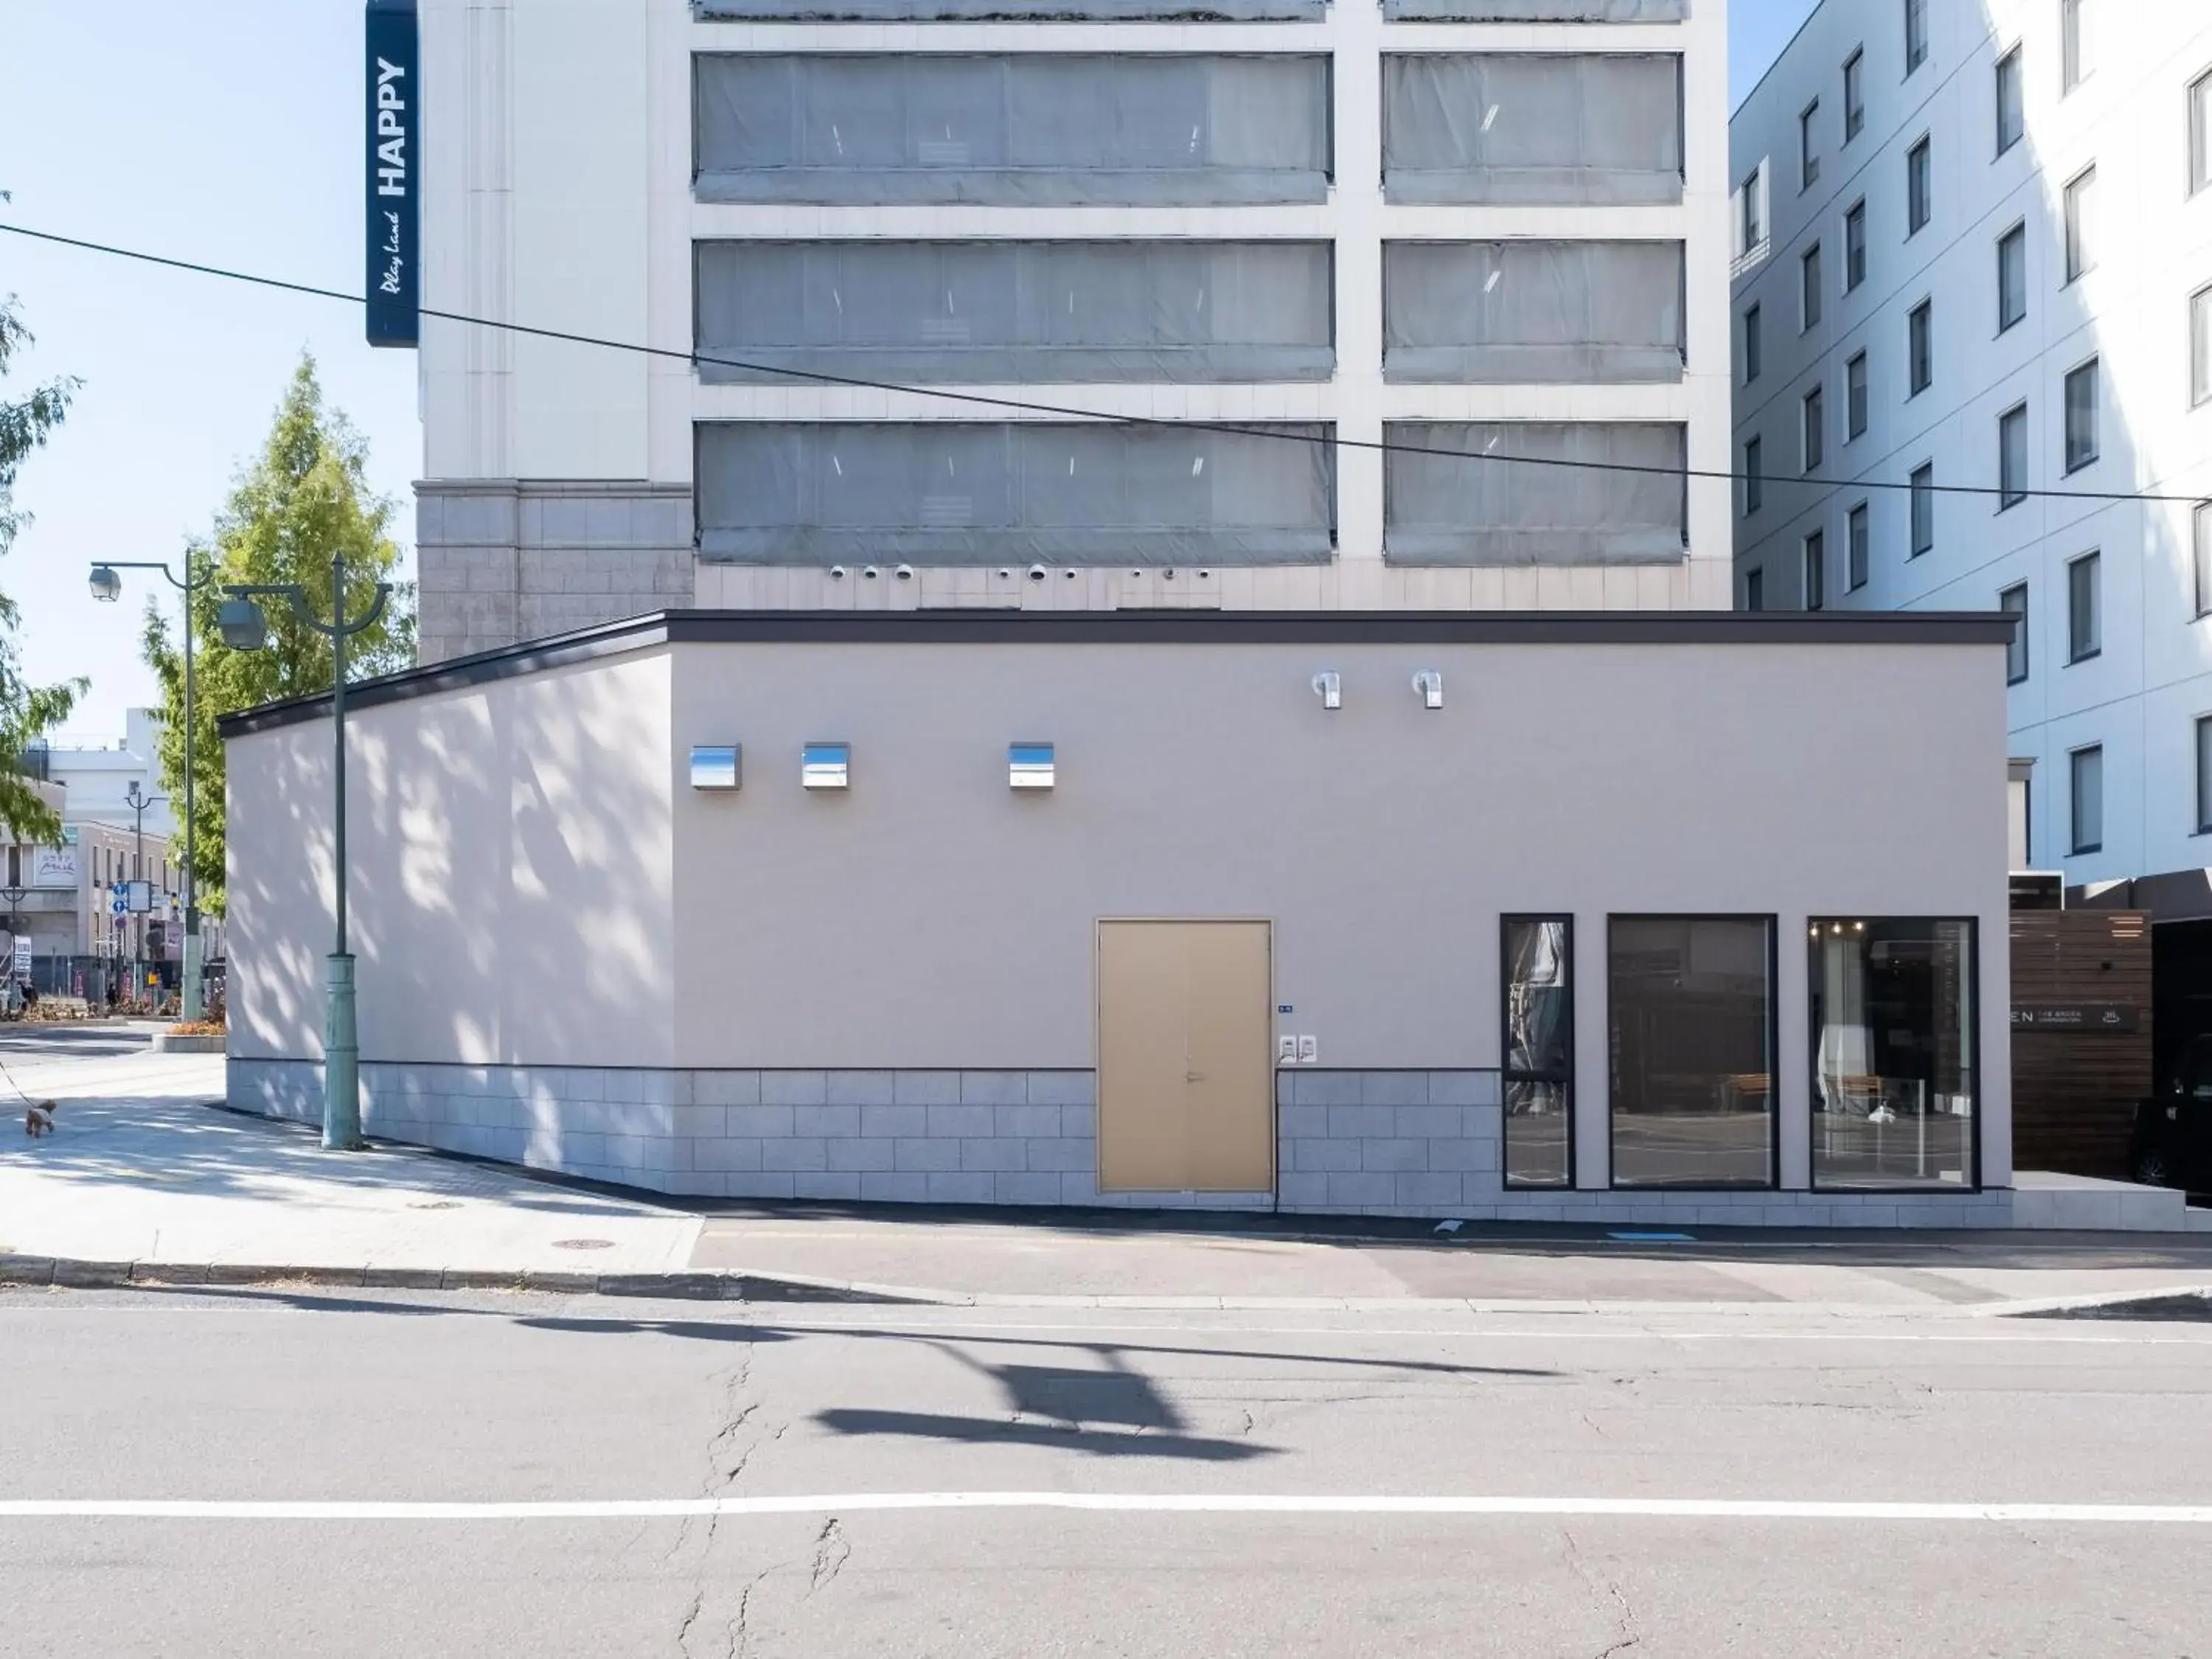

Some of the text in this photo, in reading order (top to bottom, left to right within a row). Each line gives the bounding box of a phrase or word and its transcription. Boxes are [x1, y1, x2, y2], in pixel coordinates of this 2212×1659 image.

[378, 57, 405, 294] Play Land HAPPY
